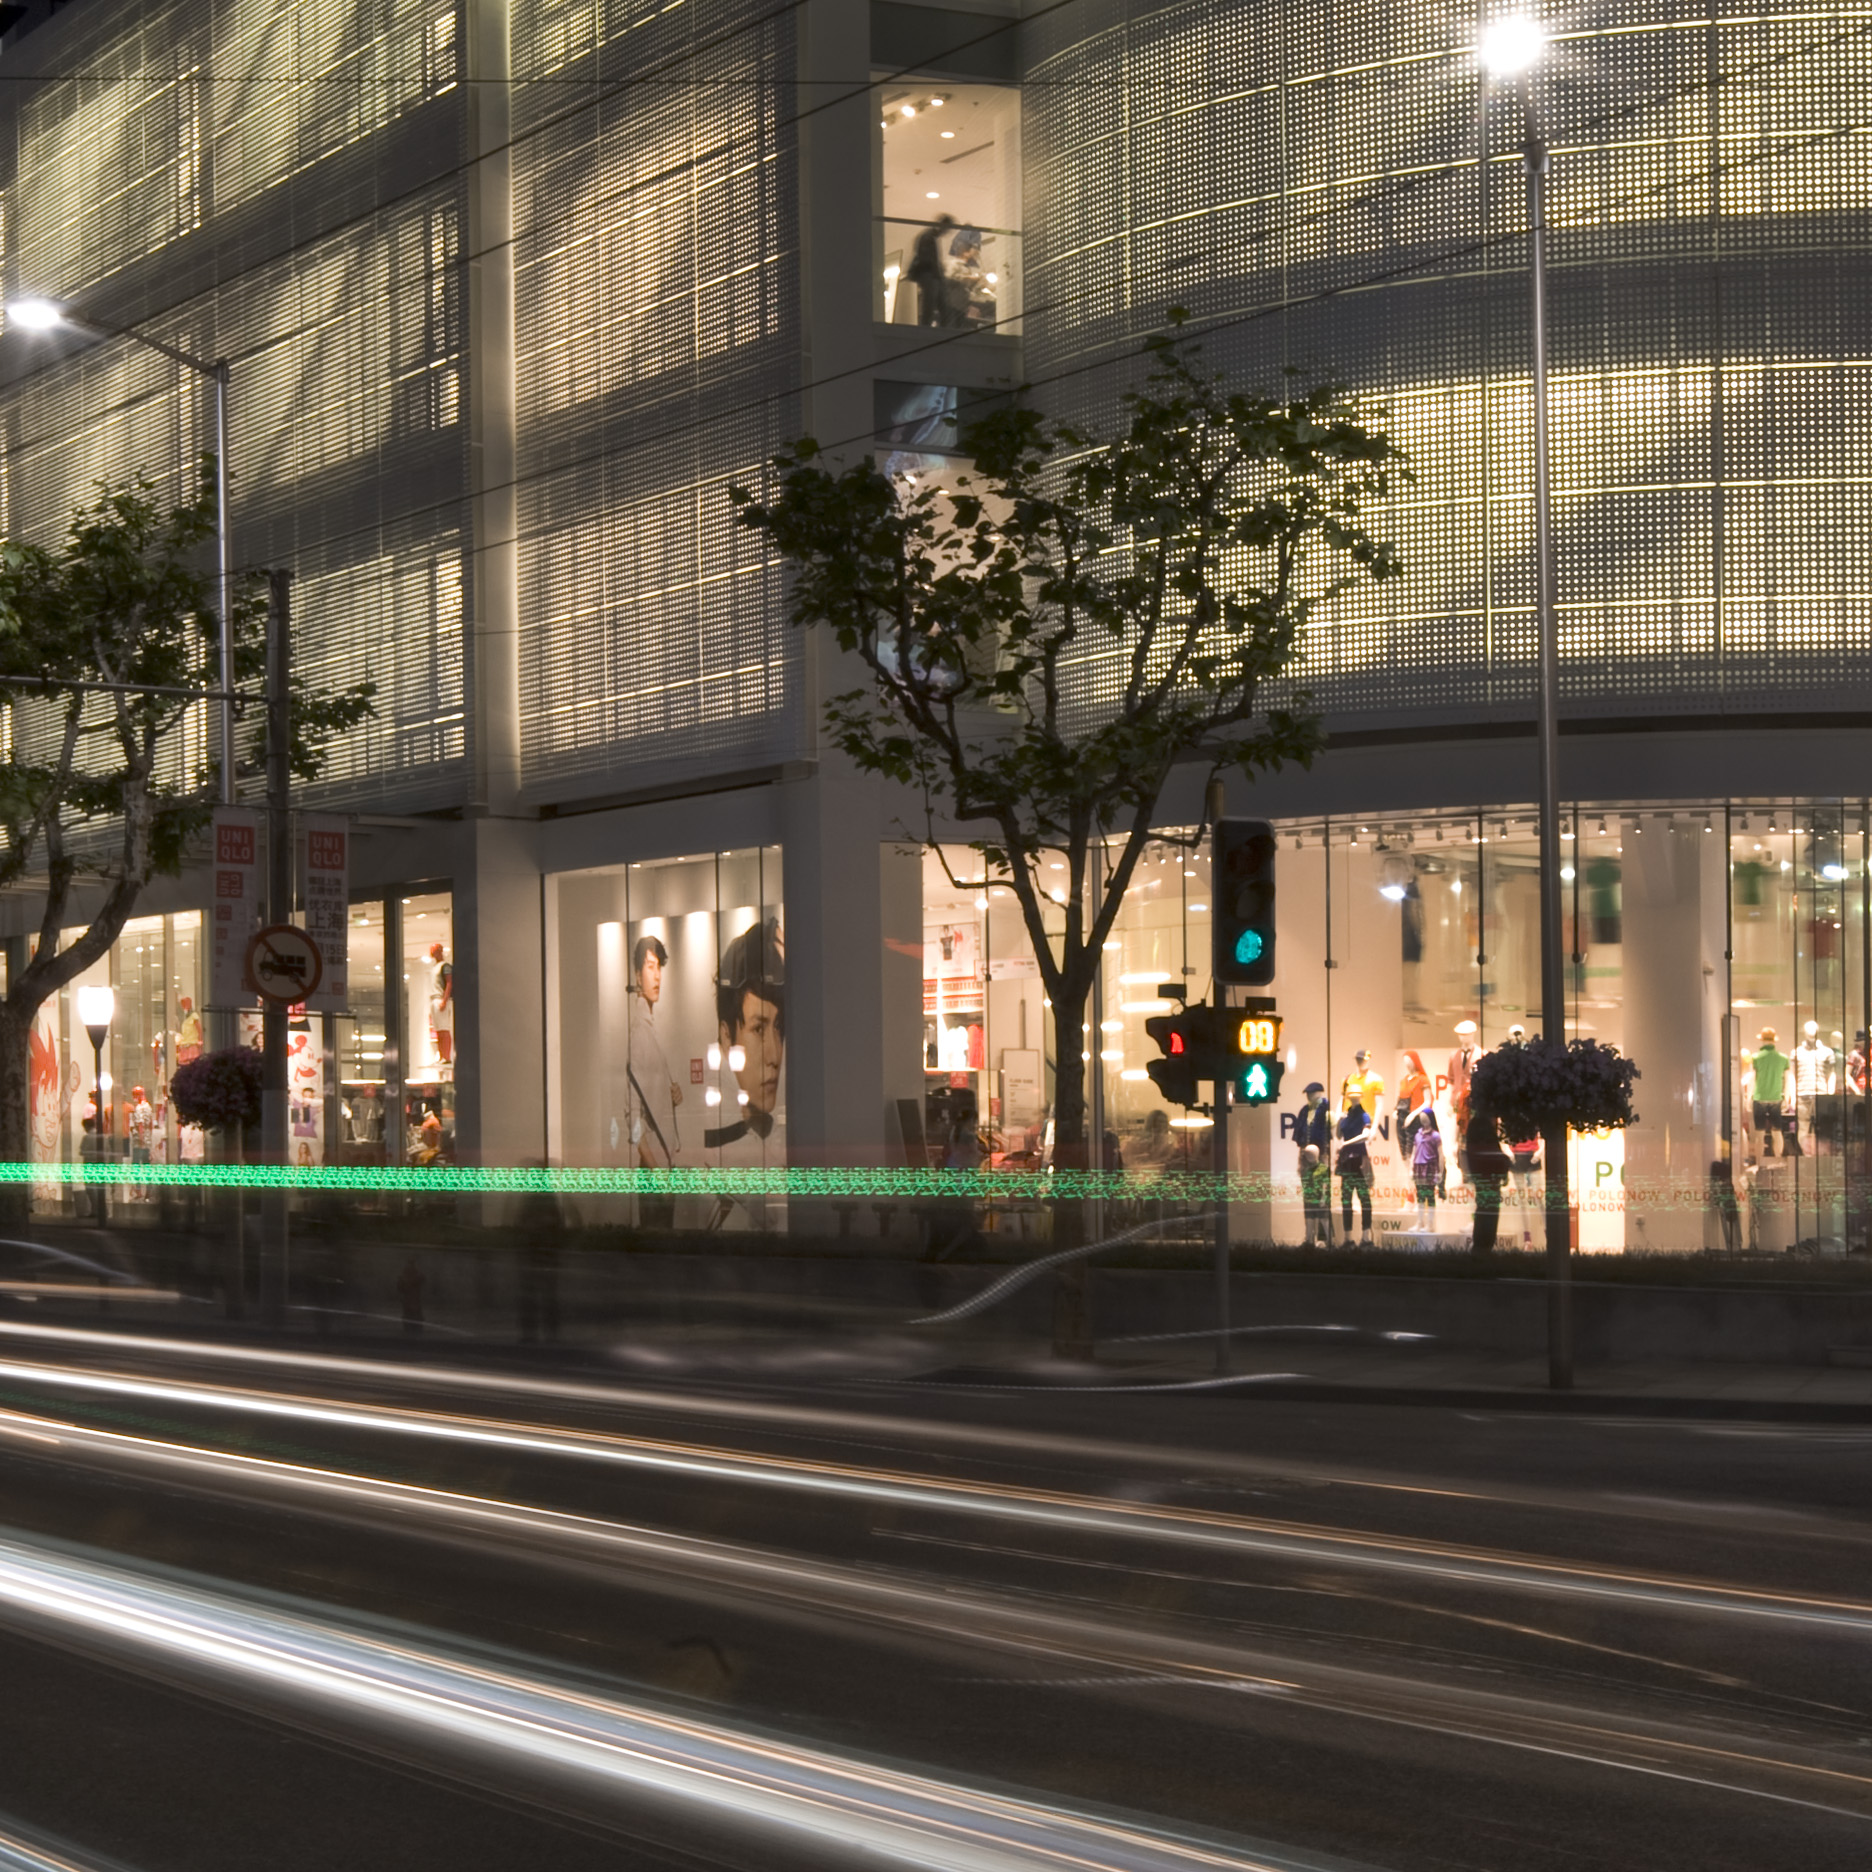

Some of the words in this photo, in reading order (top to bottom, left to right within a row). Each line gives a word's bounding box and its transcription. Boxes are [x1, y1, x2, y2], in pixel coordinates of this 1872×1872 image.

[221, 830, 249, 844] UNI
[312, 836, 339, 851] UNI
[221, 845, 250, 860] QLO
[312, 851, 341, 866] QLO
[1240, 1020, 1274, 1053] 08
